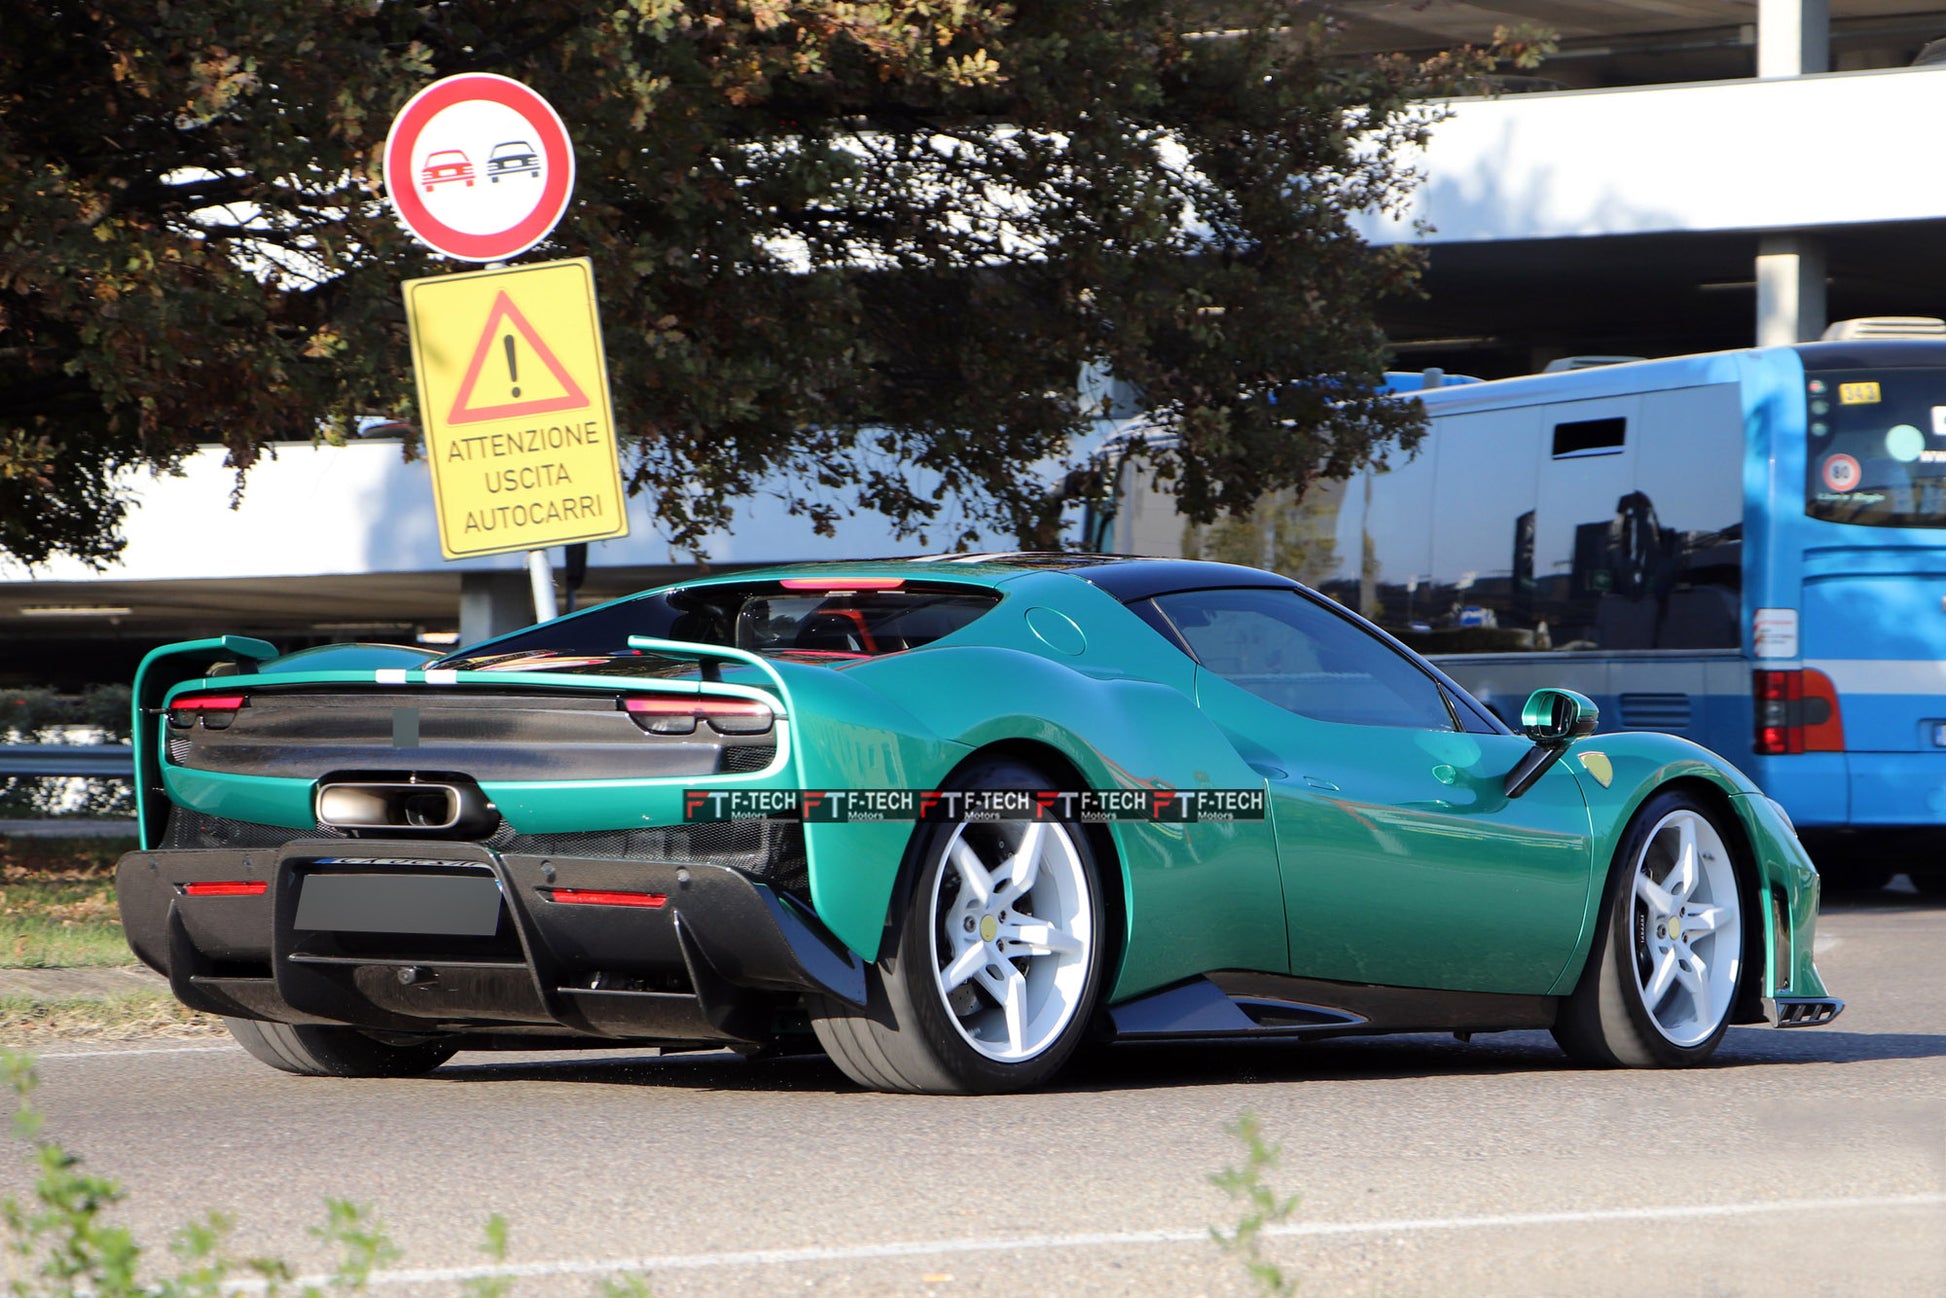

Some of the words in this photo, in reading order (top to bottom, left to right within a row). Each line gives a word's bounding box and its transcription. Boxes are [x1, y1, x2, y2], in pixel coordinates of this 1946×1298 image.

[447, 421, 600, 463] ATTENZIONE
[485, 462, 573, 493] USCITA
[463, 494, 603, 534] AUTOCARRI
